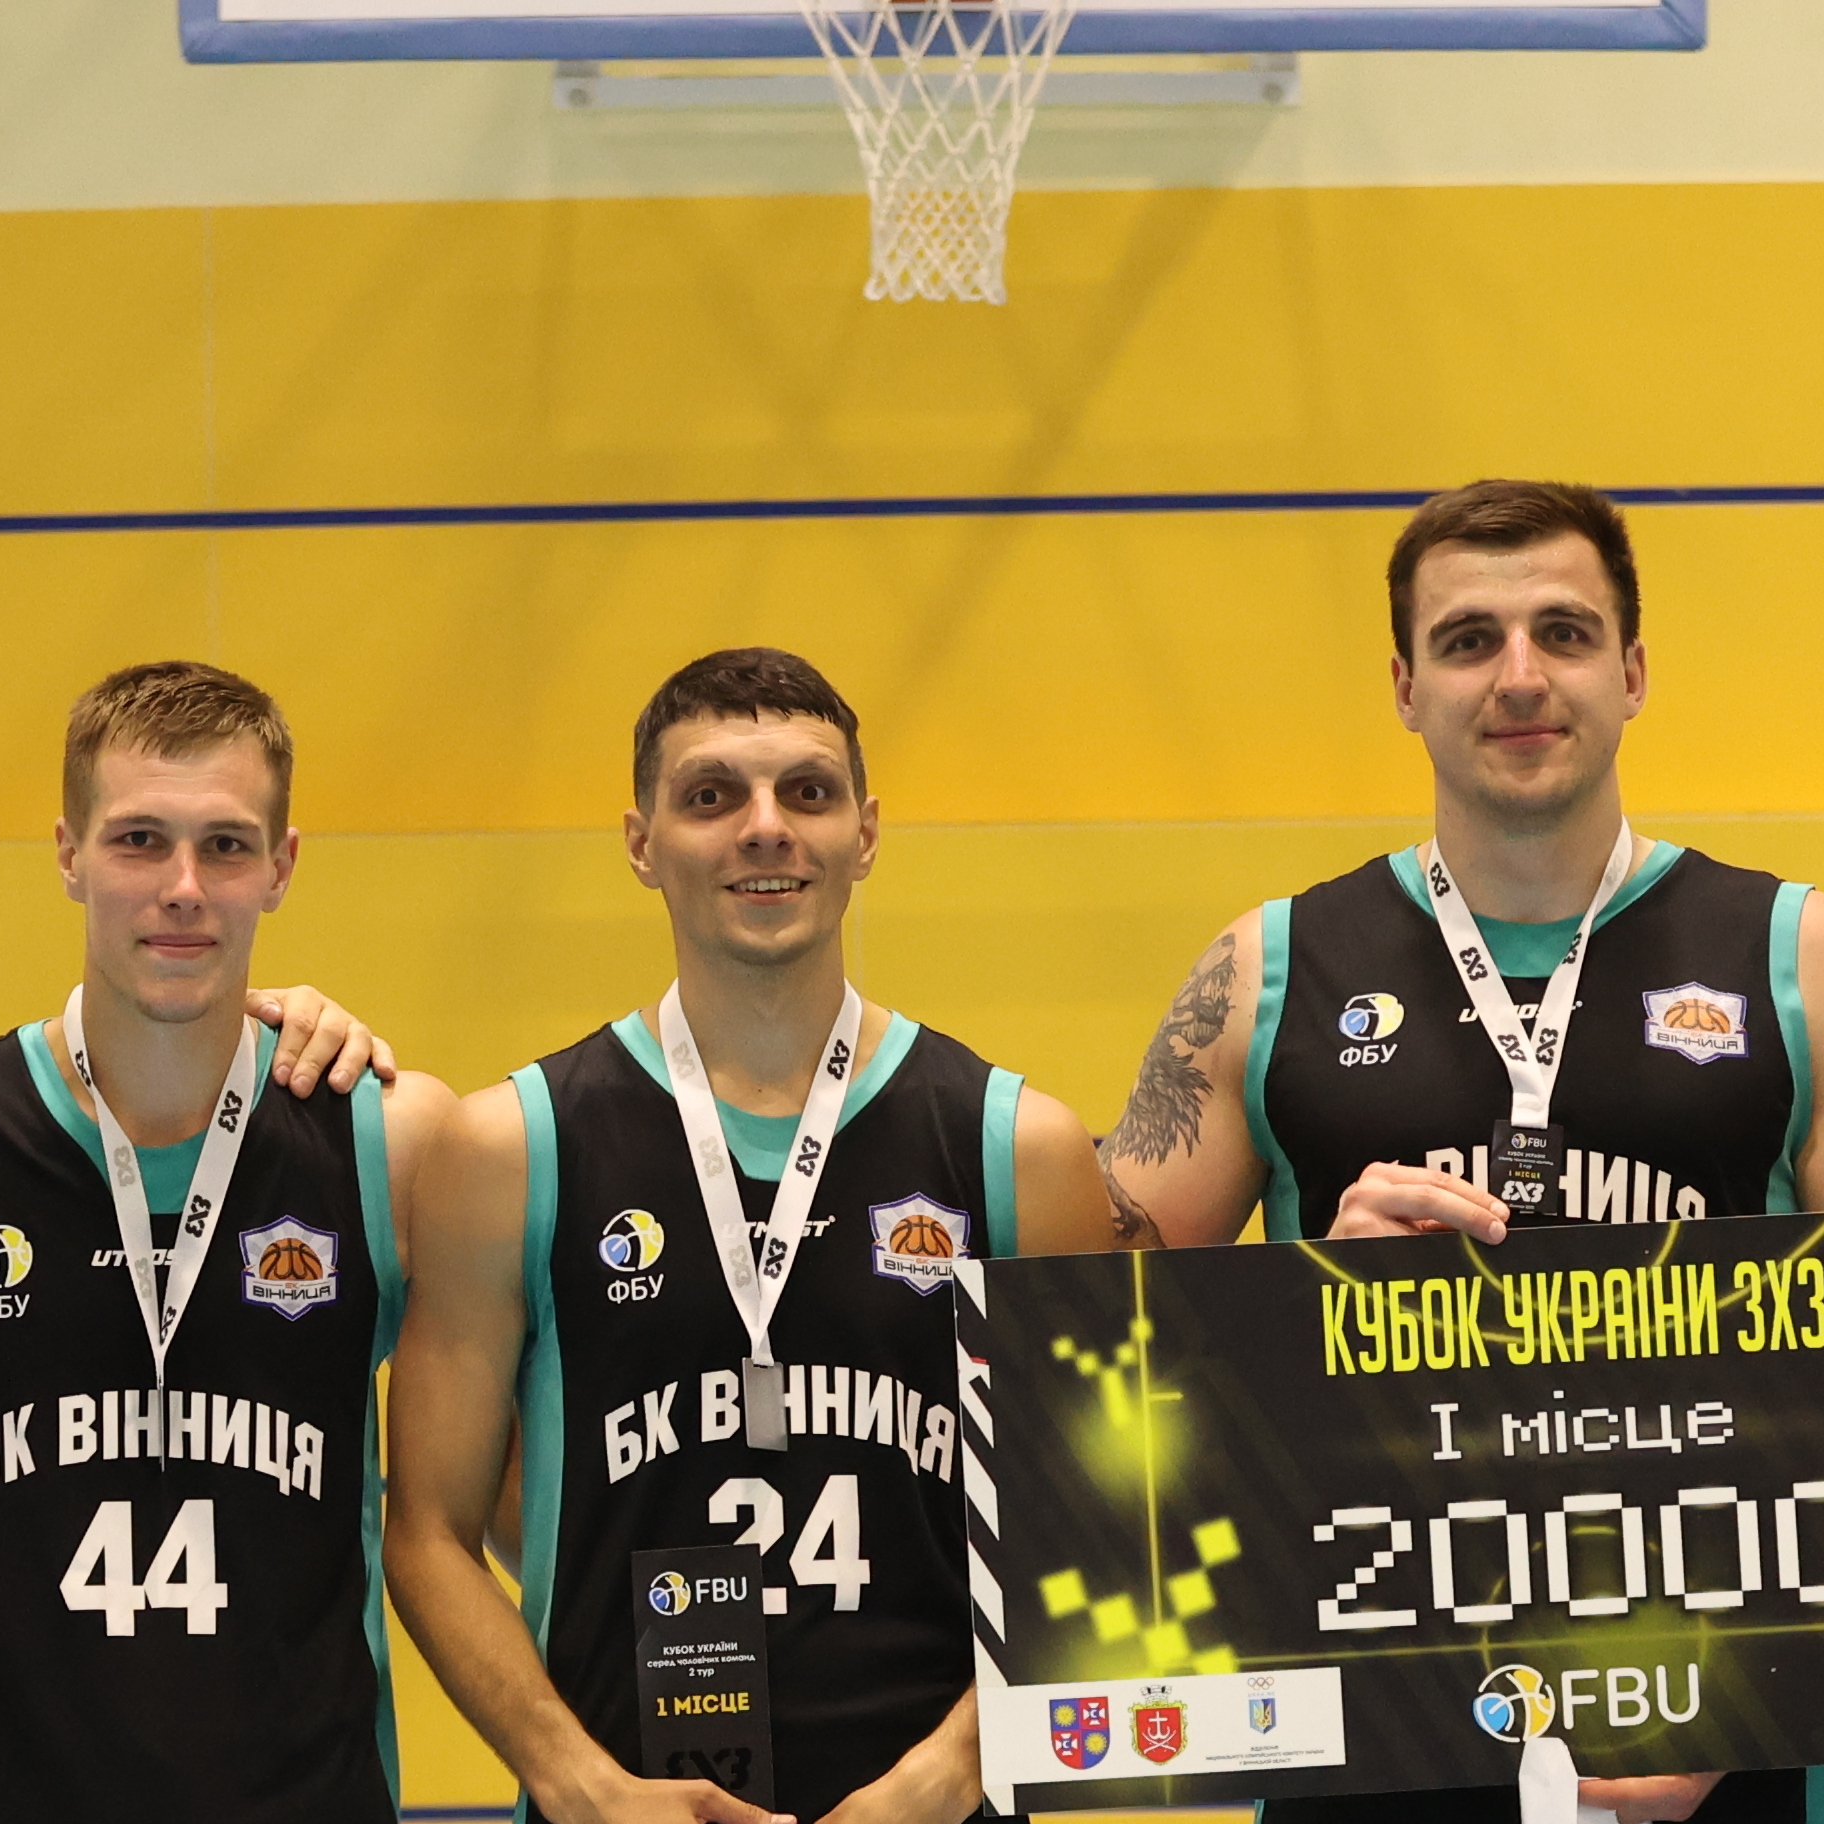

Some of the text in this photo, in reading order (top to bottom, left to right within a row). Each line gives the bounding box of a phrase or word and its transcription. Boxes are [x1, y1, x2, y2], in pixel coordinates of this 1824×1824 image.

[1339, 1043, 1398, 1068] ФБУ
[1527, 1137, 1547, 1148] FBU
[252, 1285, 331, 1300] ВІННИЦЯ
[607, 1273, 664, 1304] ФБУ
[1321, 1276, 1491, 1377] КУБОК
[604, 1364, 956, 1485] БК ВННИЦЯ
[1501, 1389, 1735, 1458] місце
[58, 1389, 324, 1501] ВІННИЦЯ
[709, 1474, 871, 1615] 24
[60, 1499, 228, 1637] 44
[695, 1575, 748, 1604] FBU
[647, 1659, 676, 1668] серед
[721, 1654, 756, 1663] команд
[663, 1641, 738, 1656] КУБОК УКРАЇНИ
[688, 1667, 714, 1678] 2 тур
[656, 1692, 750, 1717] 1 МІСЦЕ
[1560, 1661, 1702, 1731] FBU
